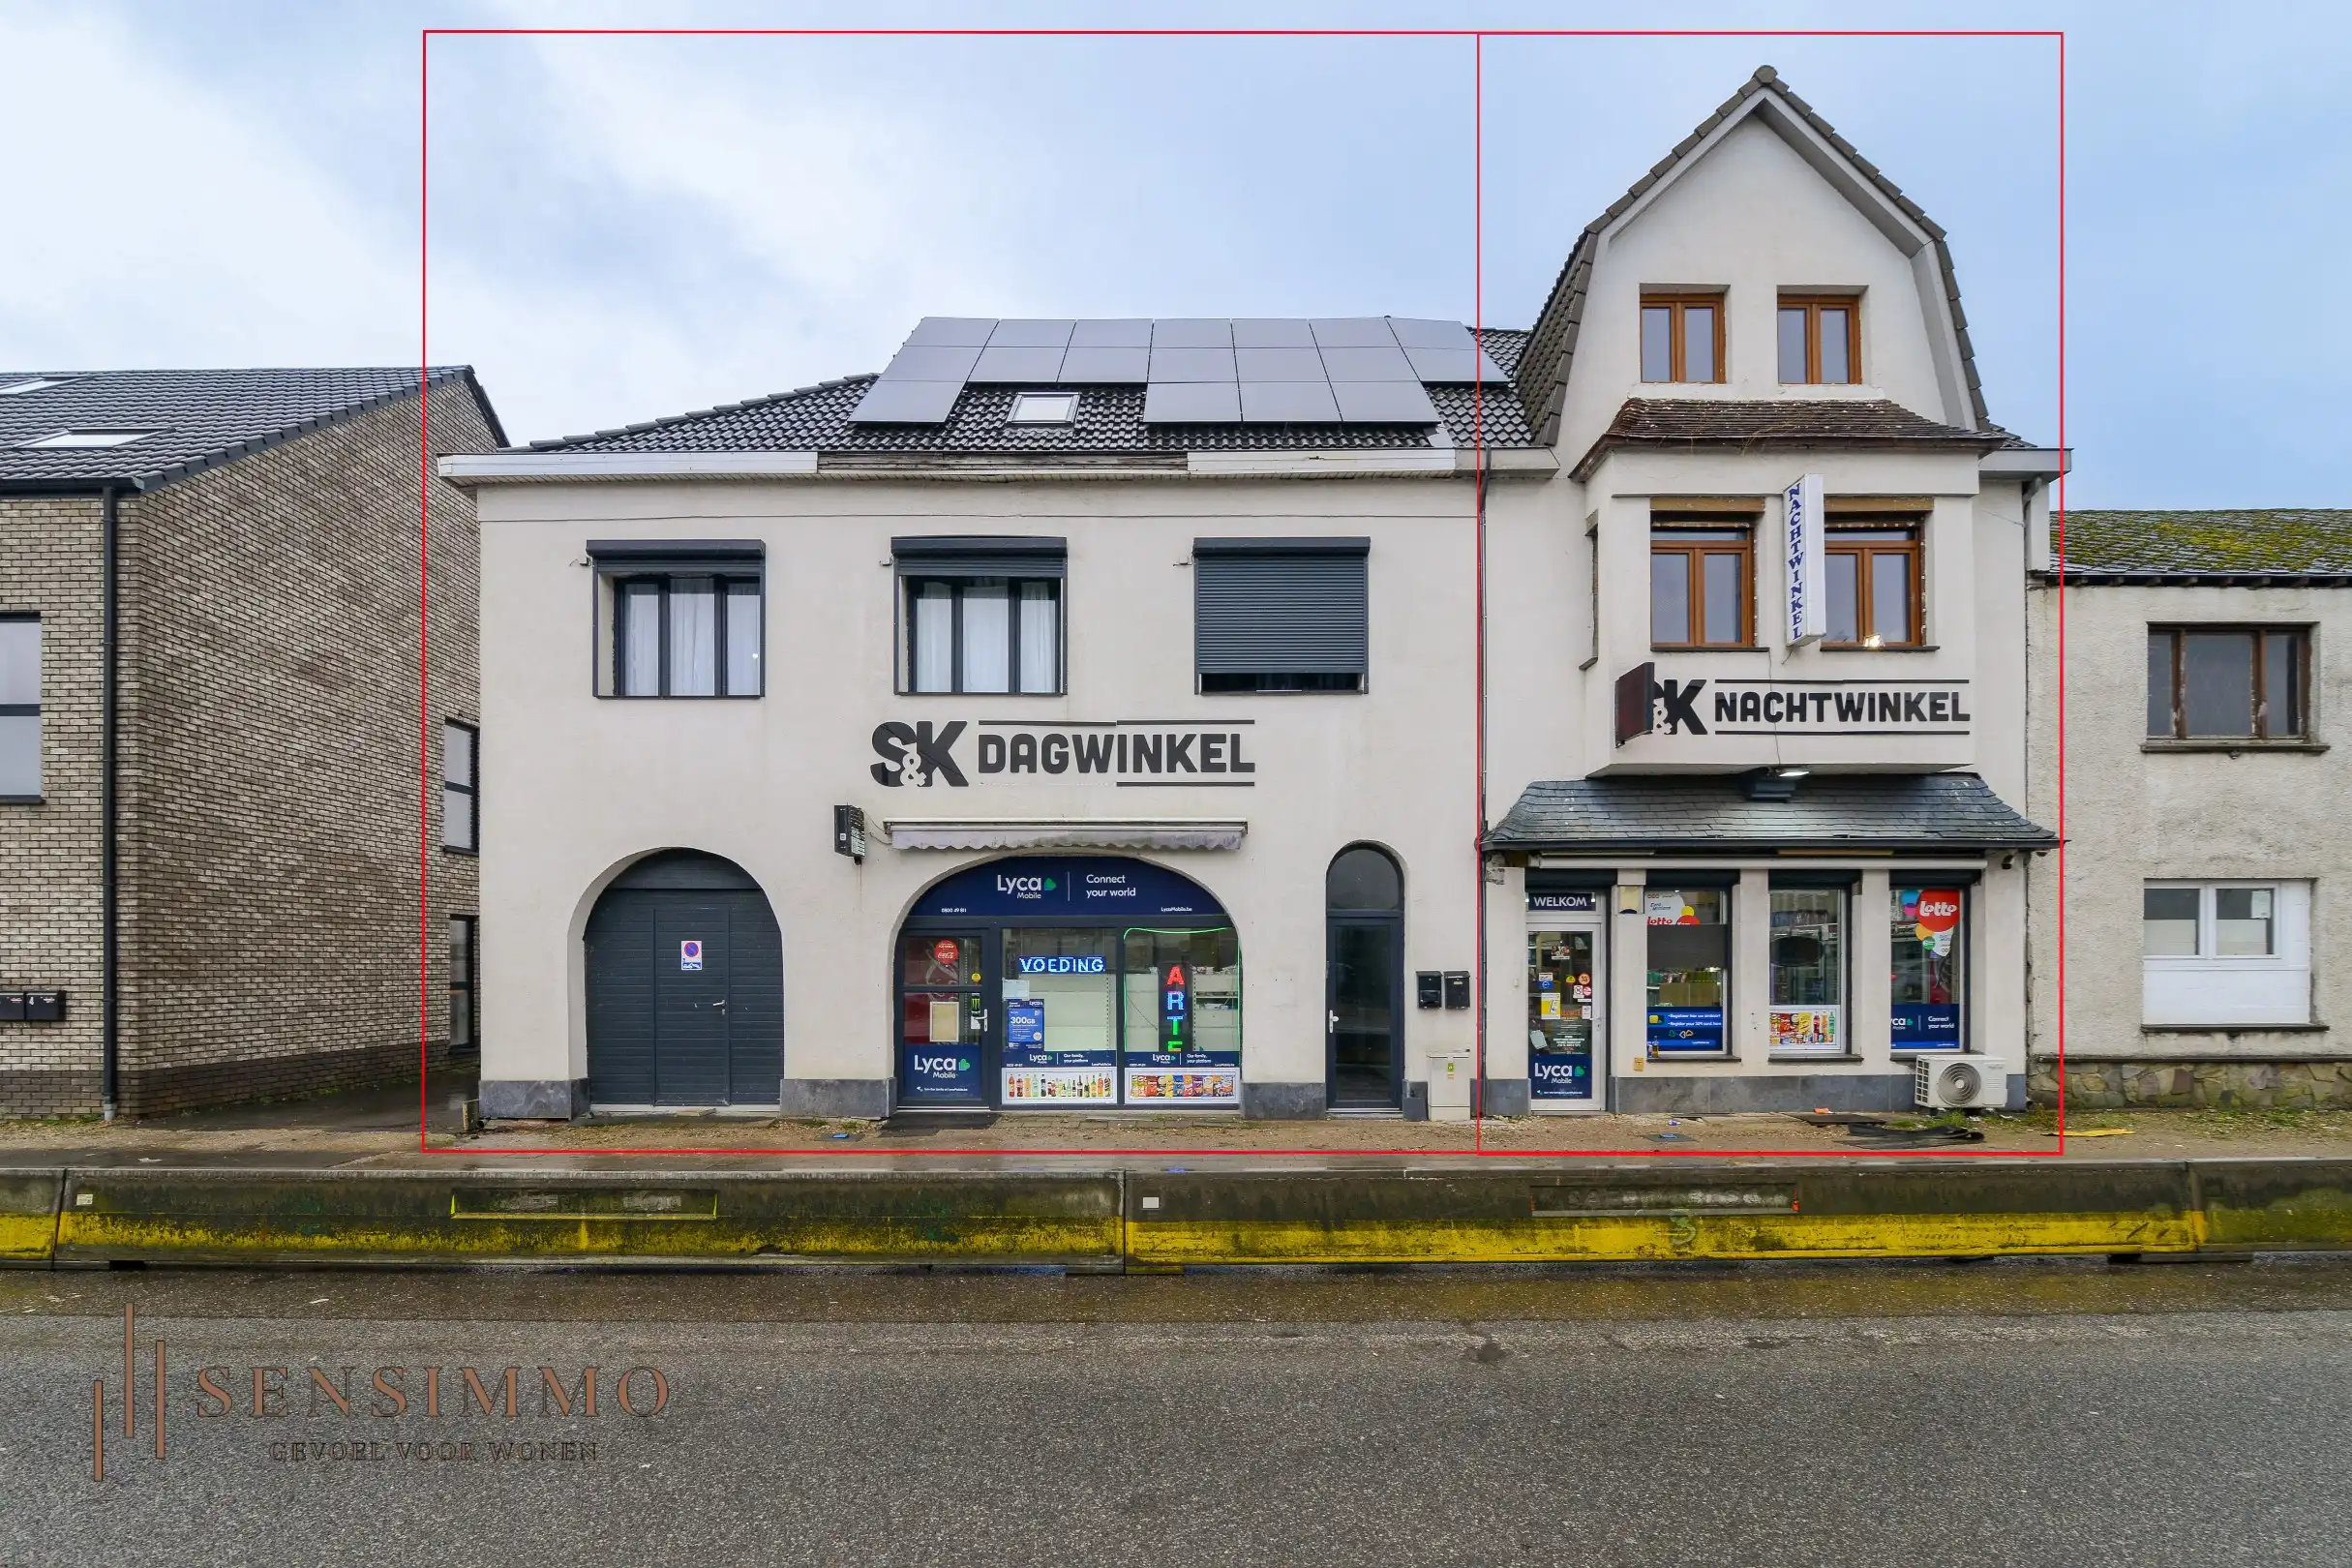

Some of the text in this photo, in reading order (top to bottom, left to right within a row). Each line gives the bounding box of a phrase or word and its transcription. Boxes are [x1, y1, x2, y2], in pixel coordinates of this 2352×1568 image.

[1787, 483, 1804, 641] NACHTWINKEL
[1653, 679, 1971, 736] &K NACHTWINKEL
[869, 720, 1255, 788] S&K DAGWINKEL
[997, 874, 1042, 894] Lyca
[1086, 874, 1126, 884] Connect
[1086, 888, 1136, 898] your world
[1533, 896, 1587, 907] WELKOM
[1020, 958, 1104, 973] VOEDING
[1891, 1017, 1906, 1026] ca
[914, 1054, 957, 1074] Lyca
[1029, 1053, 1047, 1062] Lyca
[1534, 1062, 1573, 1079] Lyca
